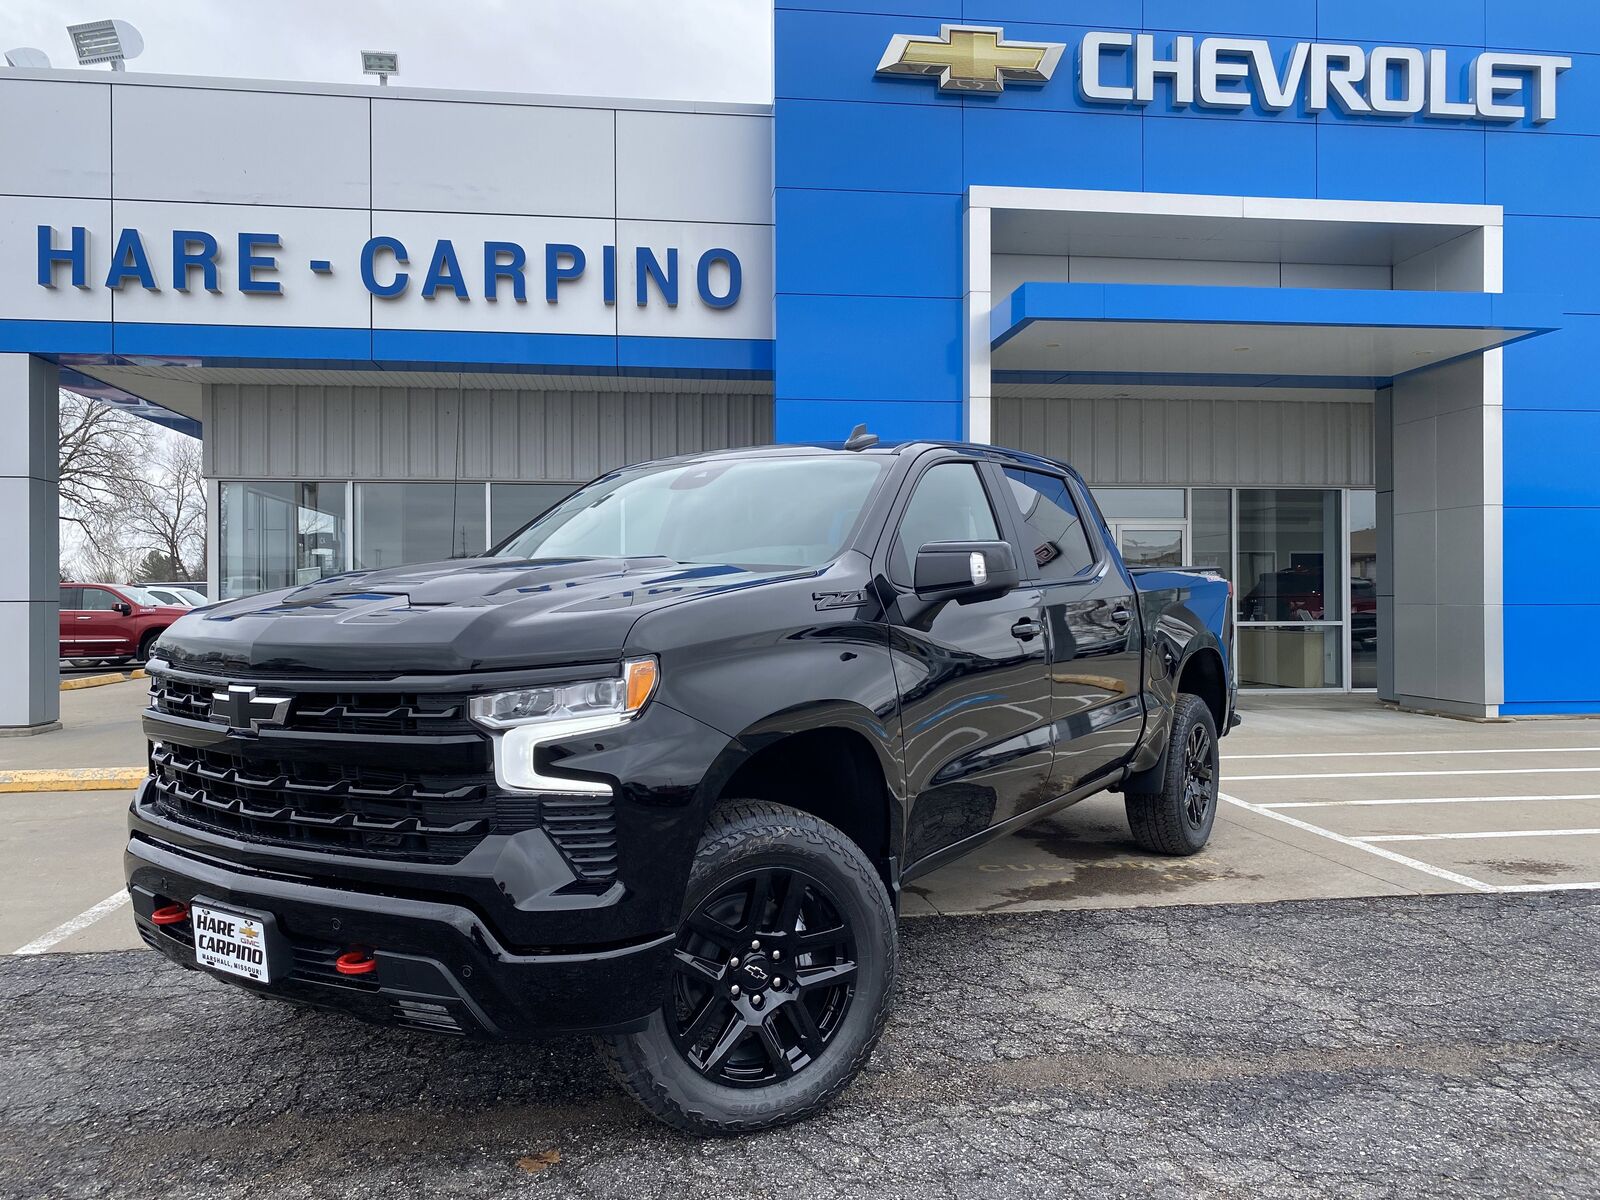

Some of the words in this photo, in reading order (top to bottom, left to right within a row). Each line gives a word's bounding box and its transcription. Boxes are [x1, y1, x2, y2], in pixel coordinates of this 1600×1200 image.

[1080, 31, 1572, 122] CHEVROLET
[37, 225, 284, 296] HARE
[360, 235, 743, 310] CARPINO
[812, 590, 867, 611] Z71
[197, 914, 235, 938] HARE
[198, 934, 263, 965] CARPINO
[240, 938, 260, 947] GMC
[234, 963, 262, 975] MISSOURI
